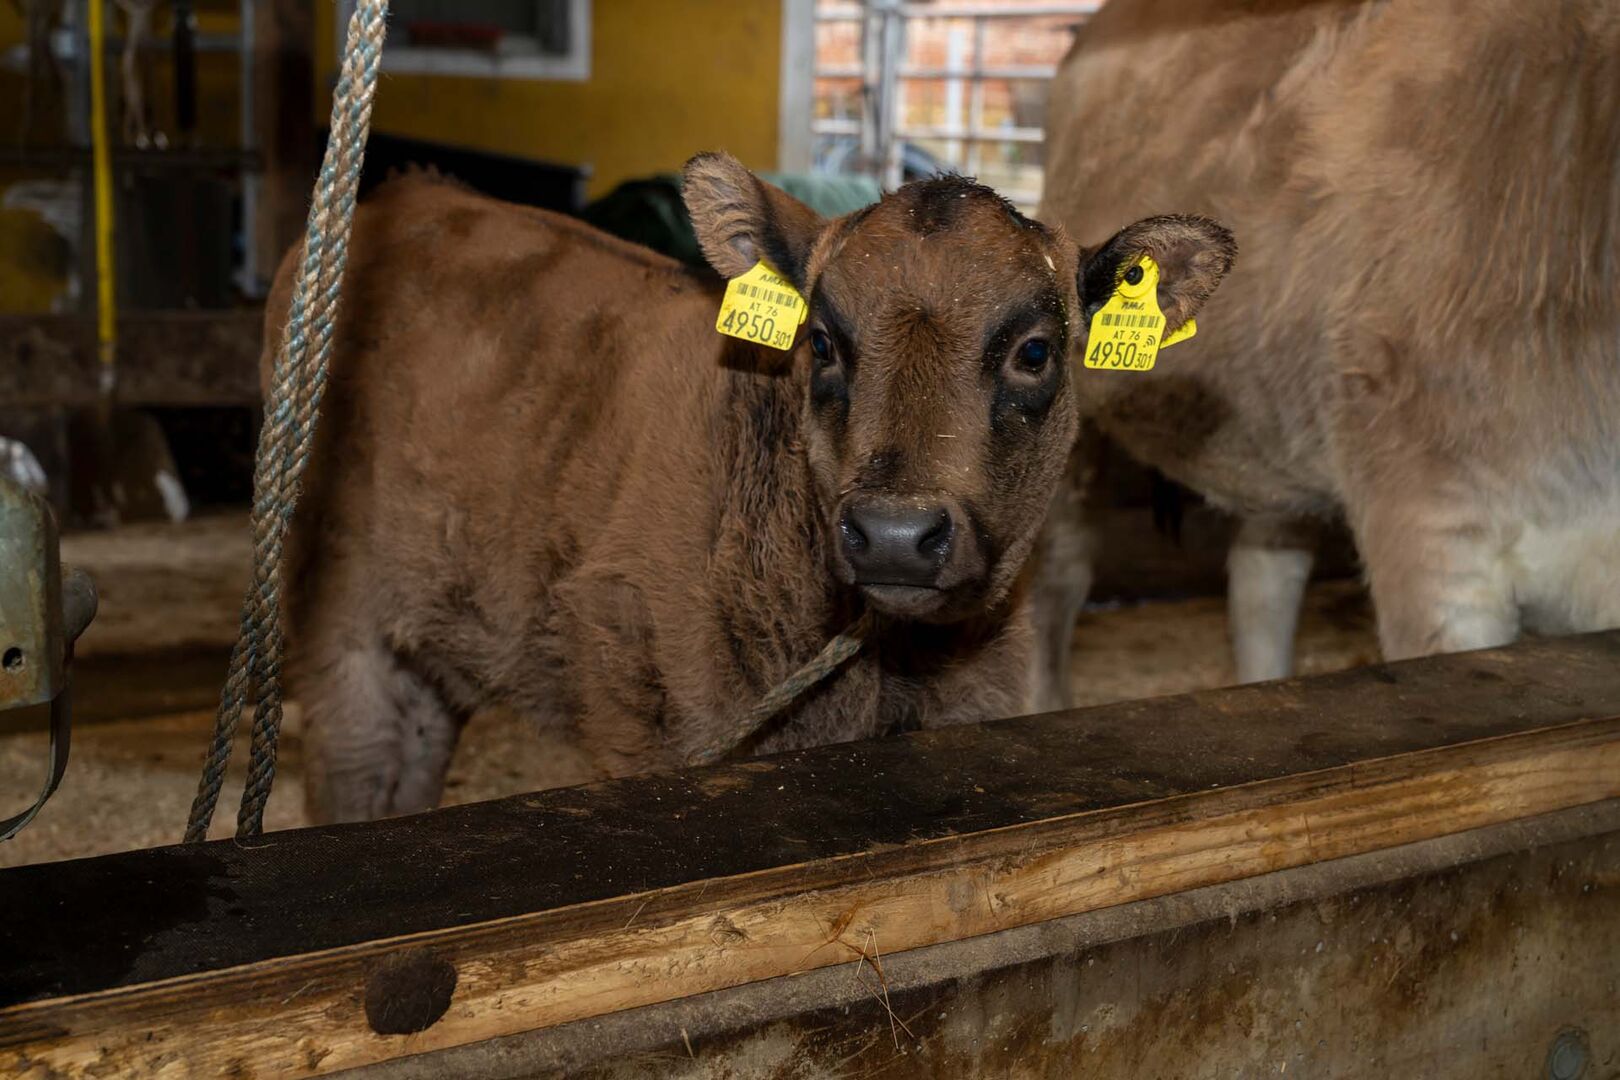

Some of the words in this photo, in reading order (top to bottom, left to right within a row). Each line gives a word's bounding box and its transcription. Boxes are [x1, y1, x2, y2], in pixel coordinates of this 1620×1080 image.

[750, 302, 761, 312] AT
[766, 306, 778, 317] 76
[722, 309, 775, 342] 4950
[773, 331, 791, 348] 301
[1113, 331, 1124, 340] AT
[1129, 331, 1140, 340] 76
[1089, 341, 1137, 368] 4950
[1135, 353, 1152, 368] 301
